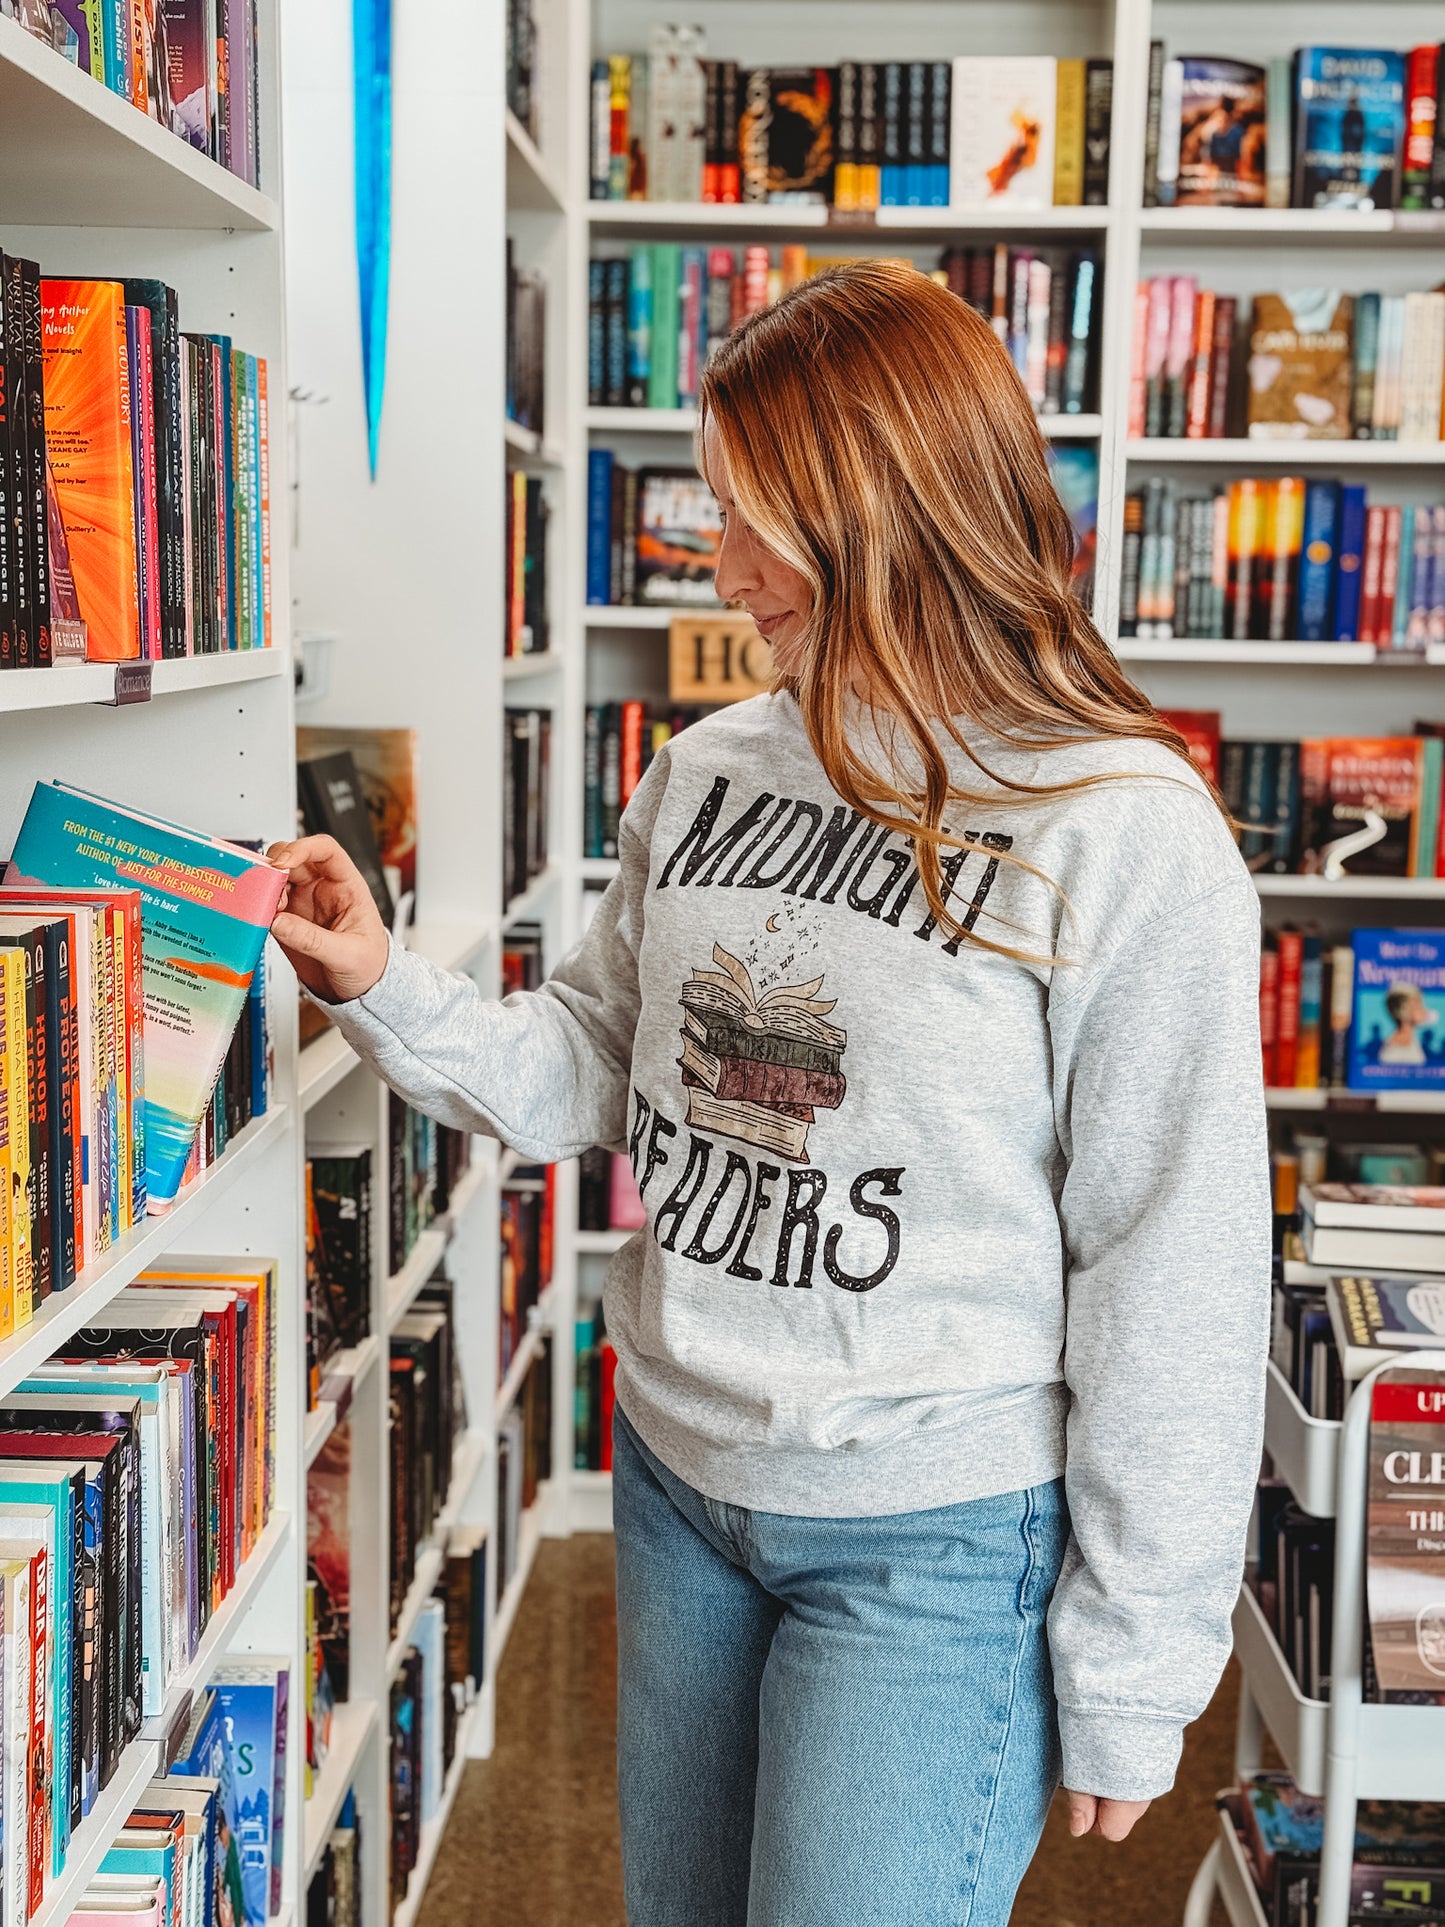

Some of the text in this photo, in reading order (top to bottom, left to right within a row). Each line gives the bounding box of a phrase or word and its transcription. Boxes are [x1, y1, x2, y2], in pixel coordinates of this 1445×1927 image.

[115, 1, 123, 61] Dahlia
[134, 3, 143, 60] LIST
[13, 272, 22, 357] BRUTAL
[24, 280, 34, 364] HEARTS
[32, 284, 42, 364] SAVAGE
[45, 322, 74, 335] Novels
[59, 304, 90, 318] Author
[242, 448, 248, 469] WE
[260, 444, 268, 500] LOVERS
[0, 491, 8, 603] GEISSINGER
[16, 490, 26, 609] GEISSINGER
[36, 489, 46, 605] GEISSINGER
[62, 634, 84, 648] GOLDEN
[119, 672, 150, 693] Romance
[63, 820, 236, 892] FROM THE #1 NEW YORK TIMES BESTSELLING
[76, 843, 214, 902] AUTHOR OF JUST FOR THE SUMMER
[152, 897, 160, 906] is
[160, 900, 179, 914] hard.
[168, 925, 187, 936] Jimenez
[153, 930, 161, 938] the
[145, 954, 155, 962] face
[175, 965, 198, 979] hardships
[150, 968, 160, 976] you
[175, 976, 186, 986] soon
[116, 962, 124, 1073] COMPLICATED
[145, 1003, 159, 1013] funny
[160, 1008, 169, 1016] and
[146, 992, 155, 1000] and
[156, 995, 167, 1005] with
[167, 1000, 176, 1008] her
[158, 1019, 172, 1028] word,
[60, 996, 71, 1136] PROTECT
[106, 1002, 114, 1074] HUNTING
[36, 1014, 46, 1123] HONOR
[99, 1165, 109, 1194] Up
[629, 1086, 906, 1292] READERS
[339, 1196, 357, 1220] 2
[16, 1256, 24, 1297] CUTE
[74, 1500, 83, 1603] HOOKED
[62, 1600, 67, 1613] A
[16, 1624, 26, 1710] playboy
[34, 1558, 46, 1726] DEJA BREW
